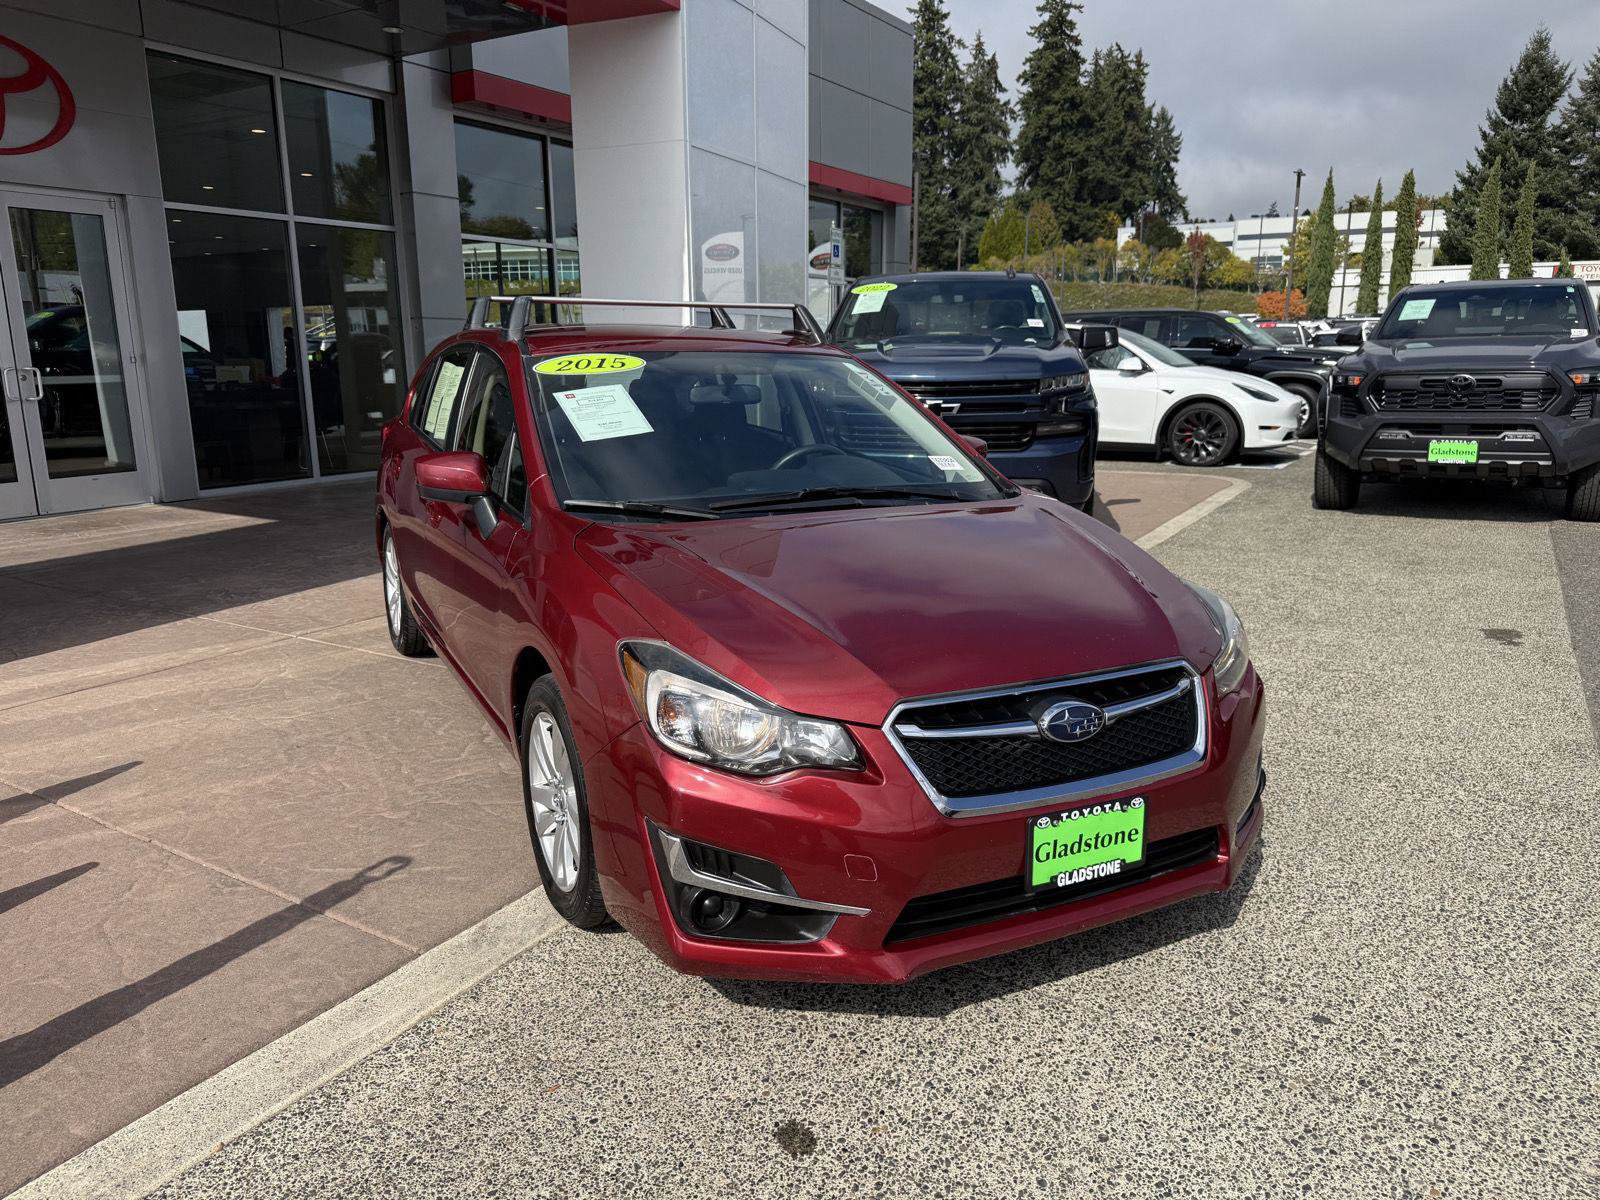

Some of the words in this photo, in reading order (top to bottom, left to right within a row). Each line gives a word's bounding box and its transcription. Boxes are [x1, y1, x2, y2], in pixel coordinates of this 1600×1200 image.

[1581, 265, 1600, 273] TOY
[556, 357, 627, 372] 2015
[1430, 447, 1476, 456] Gladstone
[1060, 801, 1121, 822] TOYOTA
[1034, 827, 1140, 864] Gladstone
[1057, 859, 1121, 888] GLADSTONE
